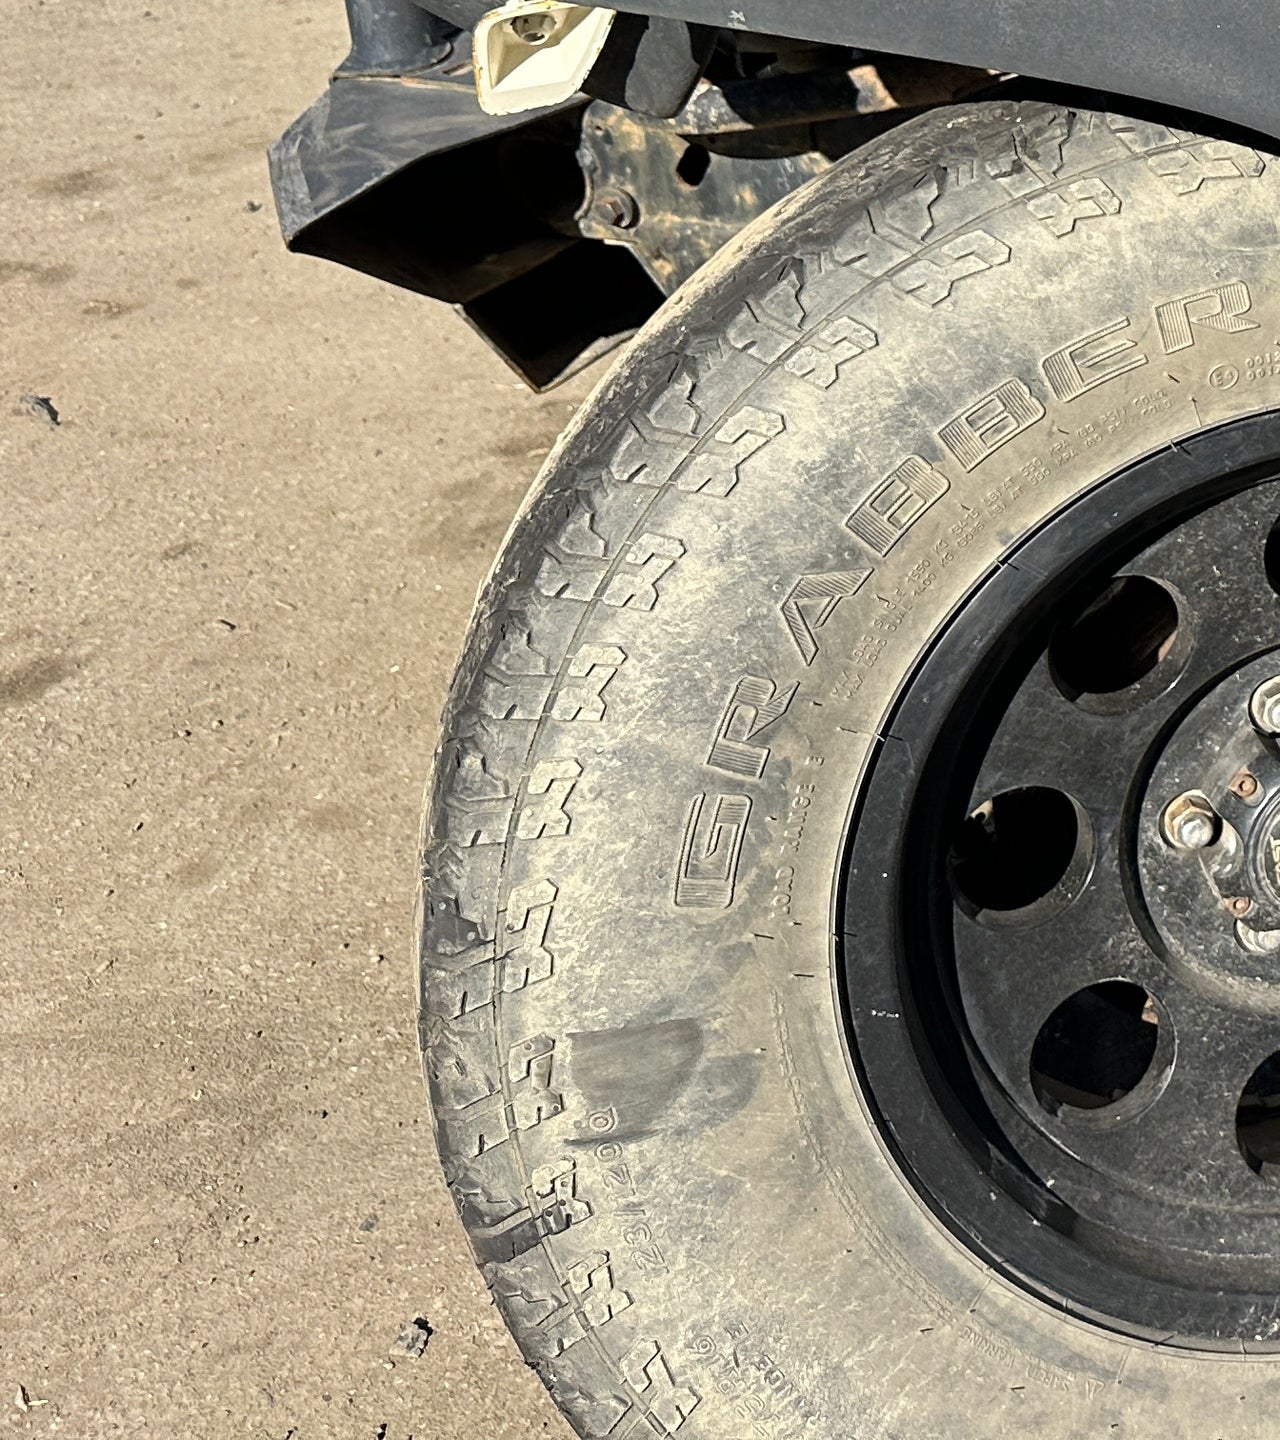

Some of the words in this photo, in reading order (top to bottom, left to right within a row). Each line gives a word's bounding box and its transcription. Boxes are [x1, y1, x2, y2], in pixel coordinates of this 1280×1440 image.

[673, 279, 1261, 909] GRABBER
[852, 634, 874, 664] LOAD
[779, 783, 816, 854] RANGE
[768, 865, 795, 920] LOAD
